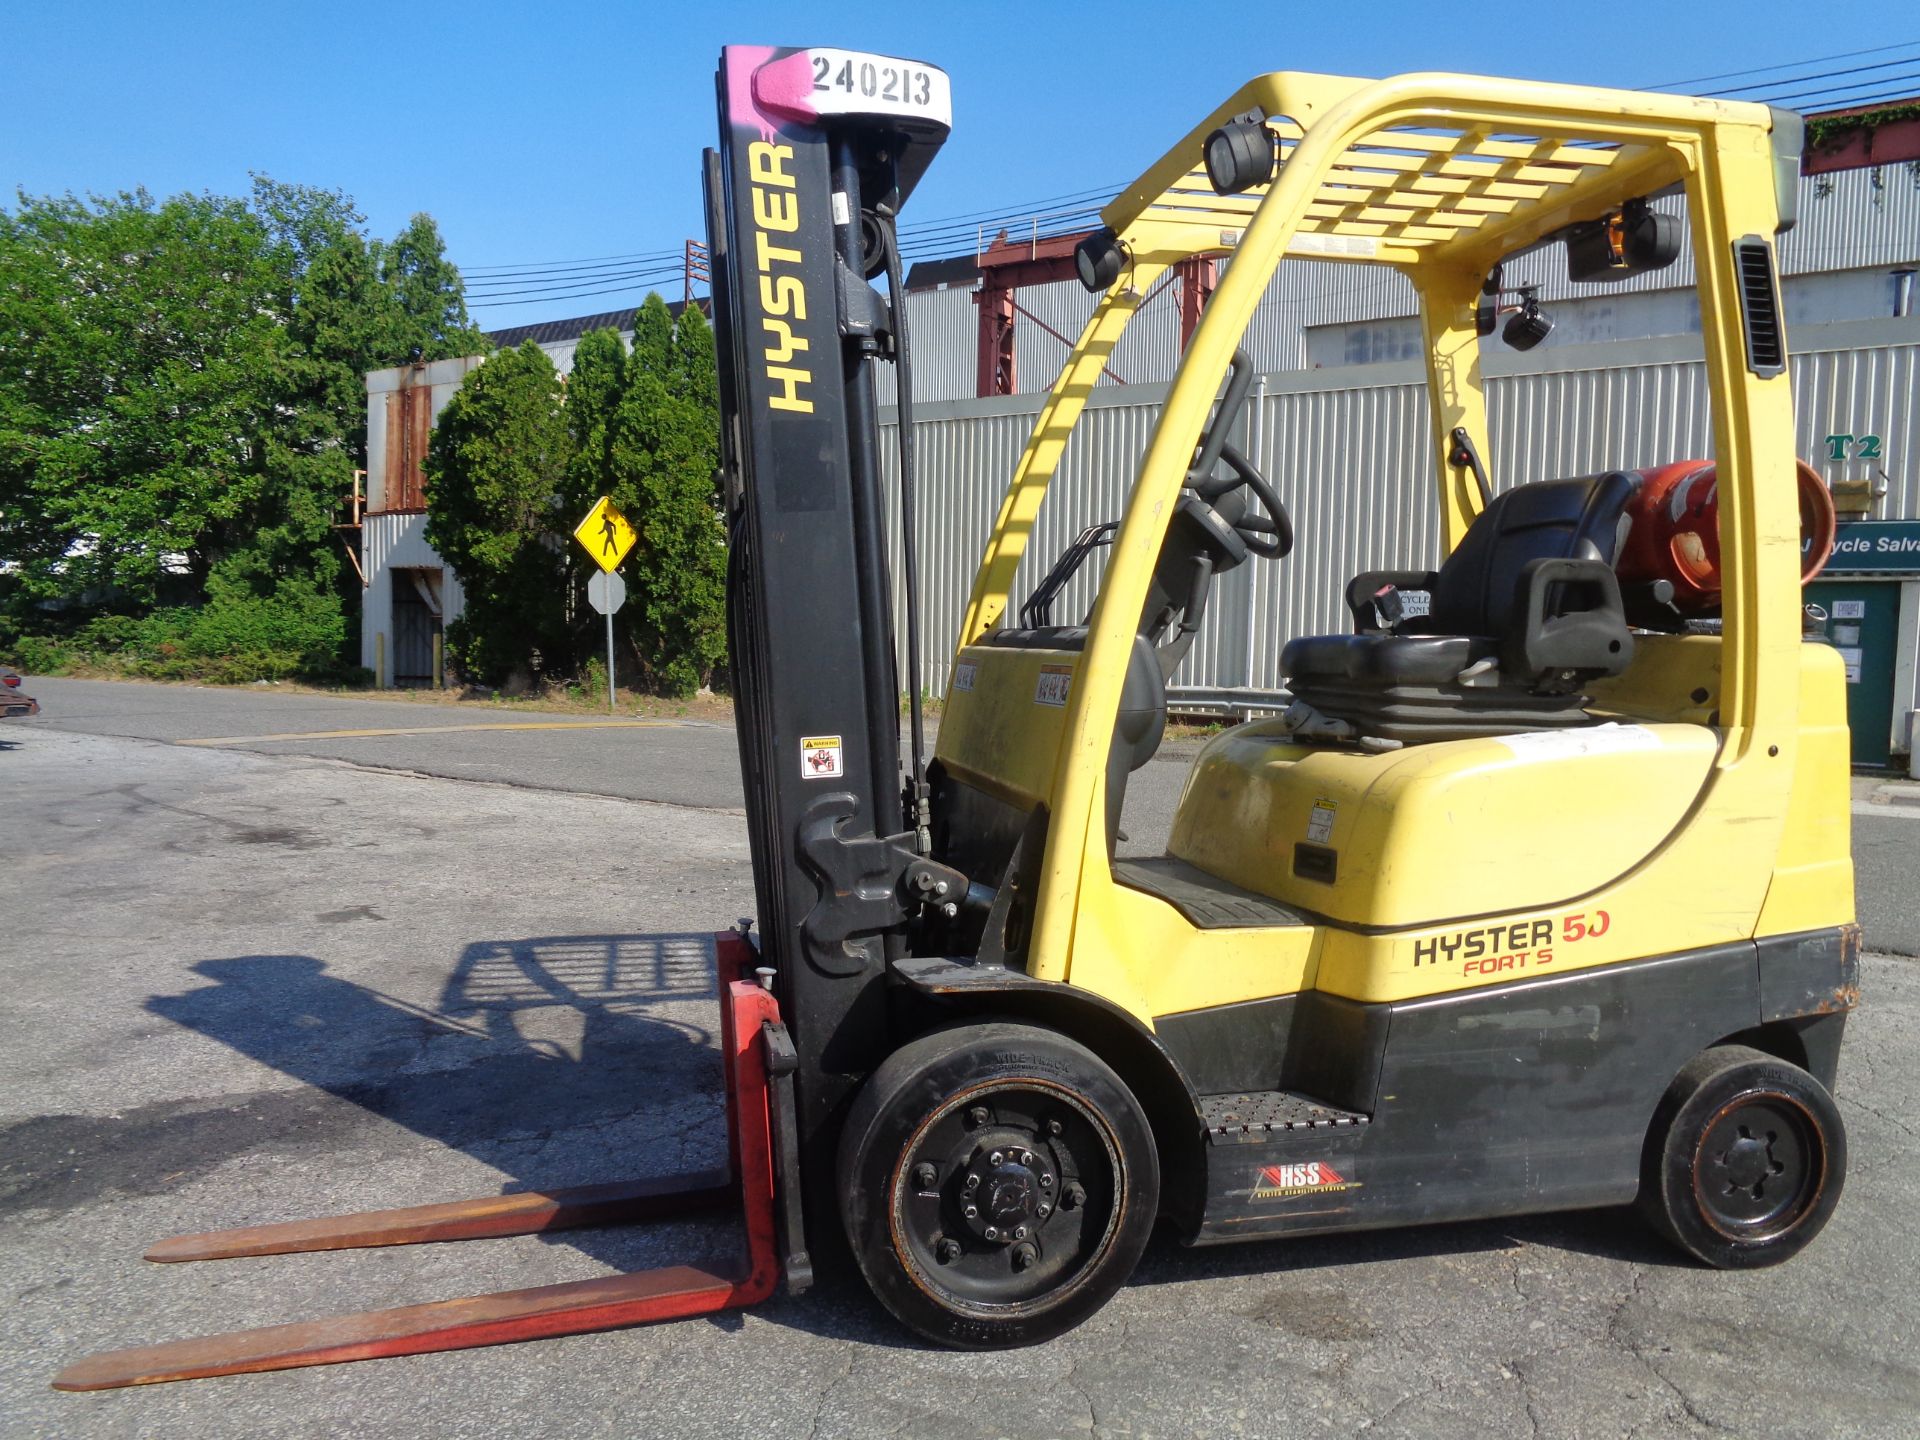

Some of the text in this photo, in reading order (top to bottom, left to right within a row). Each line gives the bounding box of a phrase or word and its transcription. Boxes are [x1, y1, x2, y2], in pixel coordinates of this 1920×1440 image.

[812, 56, 931, 106] 240213
[748, 140, 815, 414] HYSTER
[1829, 537, 1871, 556] ycle
[1408, 606, 1430, 614] ONL
[1414, 910, 1611, 967] HYSTER 50
[1280, 1161, 1320, 1188] HSS
